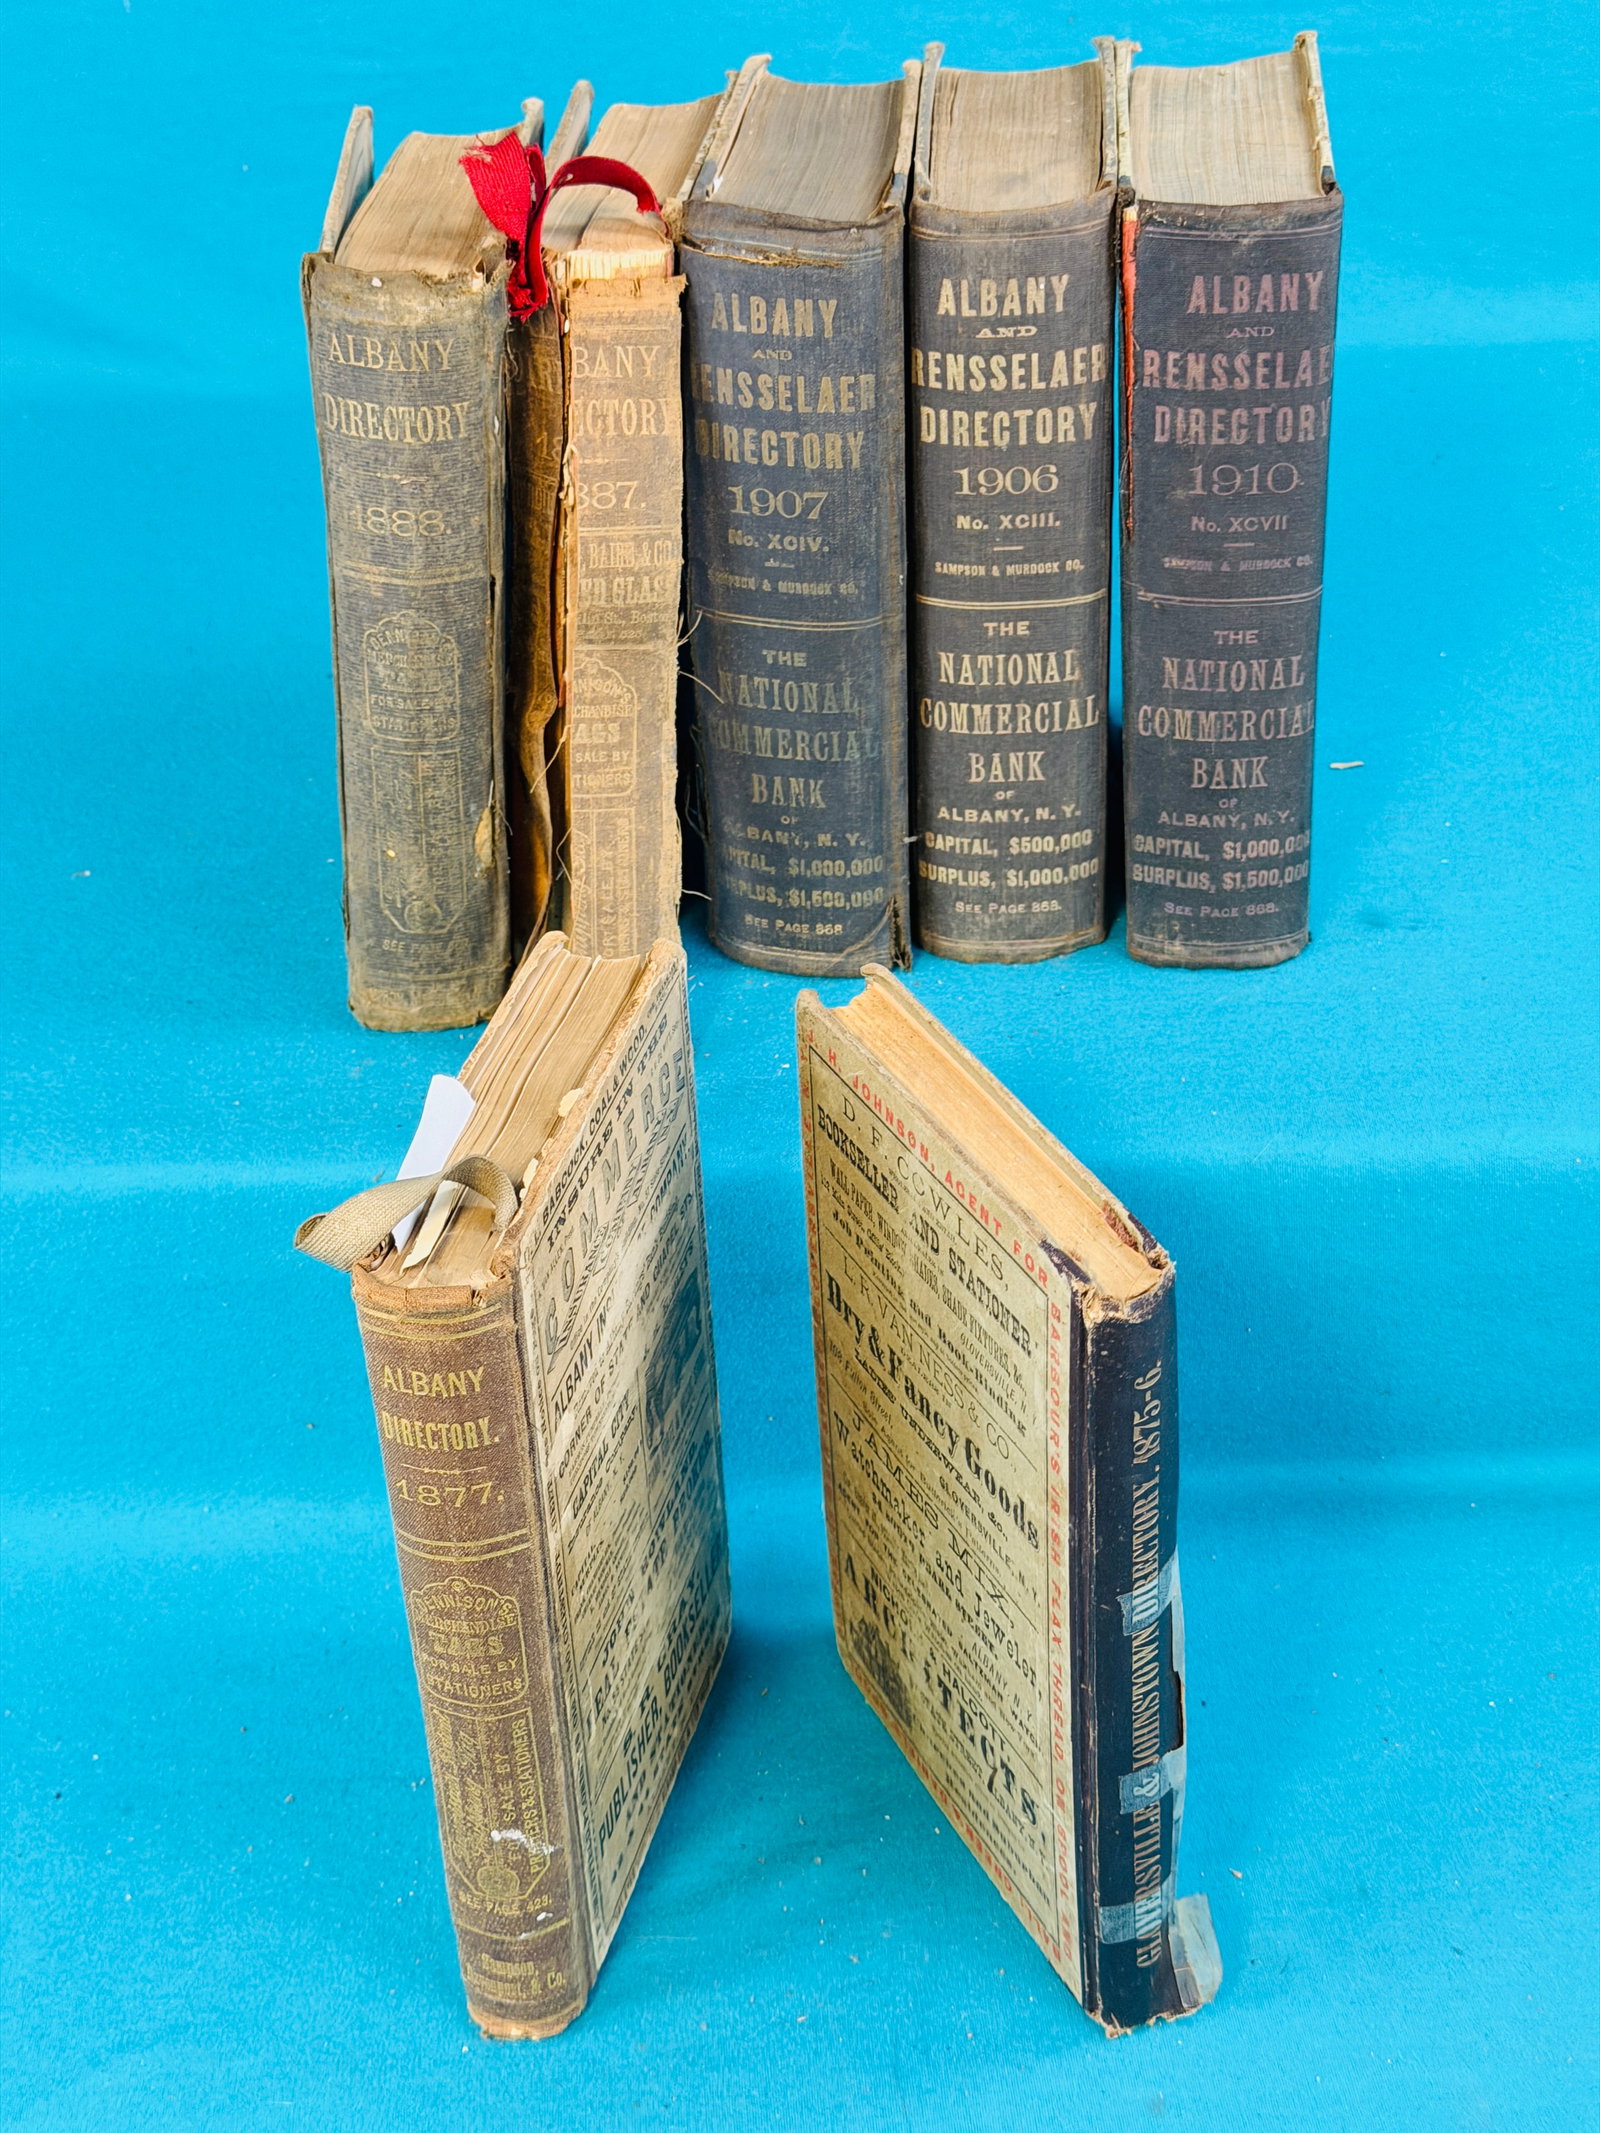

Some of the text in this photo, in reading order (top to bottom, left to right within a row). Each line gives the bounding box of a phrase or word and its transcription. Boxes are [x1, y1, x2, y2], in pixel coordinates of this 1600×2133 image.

[937, 273, 1070, 317] ALBANY
[1187, 270, 1323, 315] ALBANY
[711, 292, 838, 339] ALBANY
[975, 325, 1038, 339] AND
[1226, 326, 1275, 338] AND
[328, 334, 456, 373] ALBANY
[572, 345, 661, 378] BANY
[752, 349, 793, 361] AND
[911, 343, 1106, 393] RENSSELAER
[1142, 345, 1333, 391] RENSSELAE
[323, 395, 472, 444] DIRECTORY
[920, 402, 1097, 448] DIRECTORY
[1154, 396, 1331, 445] DIRECTORY
[695, 418, 865, 470] DIRECTORY
[577, 481, 646, 510] 887.
[953, 464, 1059, 496] 1906
[1187, 462, 1300, 496] 1910
[351, 506, 452, 536] 1888.
[728, 485, 829, 520] 1907
[956, 512, 1061, 530] No. XCIII.
[728, 529, 830, 552] No. XCIV.
[1191, 515, 1290, 532] No. XCVII
[935, 561, 986, 577] SAMPSON
[991, 565, 1000, 577] &
[1006, 561, 1060, 576] MURDOCK
[1220, 559, 1230, 571] &
[1239, 557, 1292, 571] MURDOCK
[983, 621, 1031, 637] THE
[1214, 629, 1260, 646] THE
[762, 650, 808, 667] THE
[938, 649, 1081, 686] NATIONAL
[1162, 654, 1305, 692] NATIONAL
[718, 667, 860, 715] NATIONAL
[920, 694, 1100, 735] COMMERCIAL
[1137, 699, 1315, 742] COMMERCIAL
[968, 751, 1046, 783] BANK
[1190, 756, 1269, 790] BANK
[751, 773, 827, 809] BANK
[994, 790, 1015, 801] OF
[1218, 798, 1238, 809] OF
[937, 804, 1082, 824] ALBANY, N. Y.
[1158, 810, 1296, 830] ALBANY, N. Y.
[817, 833, 838, 848] N.
[845, 832, 866, 847] Y.
[925, 828, 1093, 858] CAPITAL, $500,000
[1133, 834, 1211, 862] CAPITAL,
[788, 855, 884, 878] $1,000,000
[918, 857, 1100, 889] SURPLUS, $1,000,000
[1132, 860, 1309, 893] SURPLUS, $1,500,000
[788, 886, 885, 910] $1,500,000
[988, 902, 1026, 914] PAGE
[1200, 905, 1240, 918] PAGE
[775, 919, 810, 934] PAGE
[542, 1127, 587, 1231] BABCOCK,
[589, 1080, 612, 1140] COAL
[612, 1070, 618, 1095] &
[619, 1013, 647, 1082] WOOD.
[547, 1112, 613, 1258] INSURE
[615, 1075, 633, 1123] IN
[637, 1010, 667, 1082] THE
[543, 1043, 685, 1354] COMMERCE
[817, 1102, 899, 1215] BOOKSELLER
[908, 1200, 939, 1261] AND
[852, 1071, 935, 1174] JOHNSON,
[943, 1164, 1002, 1243] AGENT
[1012, 1235, 1048, 1291] FOR
[552, 1326, 594, 1436] ALBANY
[877, 1294, 913, 1355] VAN
[918, 1341, 964, 1412] NESS
[967, 1396, 980, 1430] &
[383, 1365, 485, 1400] ALBANY
[938, 1324, 1026, 1439] Book-Binding
[1050, 1300, 1060, 1478] BARBOUR'S
[558, 1400, 591, 1484] CORNER
[594, 1371, 606, 1408] OF
[825, 1267, 866, 1355] Dry
[867, 1317, 884, 1370] &
[887, 1342, 959, 1467] Fancy
[964, 1431, 1039, 1554] Goods
[1132, 1358, 1163, 1465] 1875-6.
[381, 1410, 501, 1452] DIRECTORY.
[572, 1384, 630, 1524] CAPITAL CITY
[396, 1478, 504, 1508] 1877.
[567, 1470, 603, 1558] Insurance
[852, 1404, 938, 1536] JAMES
[947, 1524, 1014, 1632] MIX,
[939, 1473, 1014, 1577] GLOVERSVILLE,
[1049, 1480, 1061, 1571] IRISH
[833, 1408, 925, 1551] Watchmaker
[934, 1539, 963, 1599] and
[973, 1587, 1042, 1704] Jeweler,
[1131, 1464, 1161, 1623] DIRECTORY.
[1050, 1575, 1062, 1652] FLAX
[451, 1661, 490, 1675] SALE
[498, 1657, 519, 1672] BY
[427, 1675, 524, 1698] STATIONERS
[1131, 1621, 1161, 1770] JOHNSTOWN
[942, 1658, 1010, 1764] HALCOTT,
[1051, 1654, 1064, 1772] THREAD,
[512, 1718, 536, 1798] STATIONERS
[598, 1682, 662, 1861] PUBLISHER,
[494, 1754, 517, 1821] SALE BY
[1133, 1773, 1160, 1798] &
